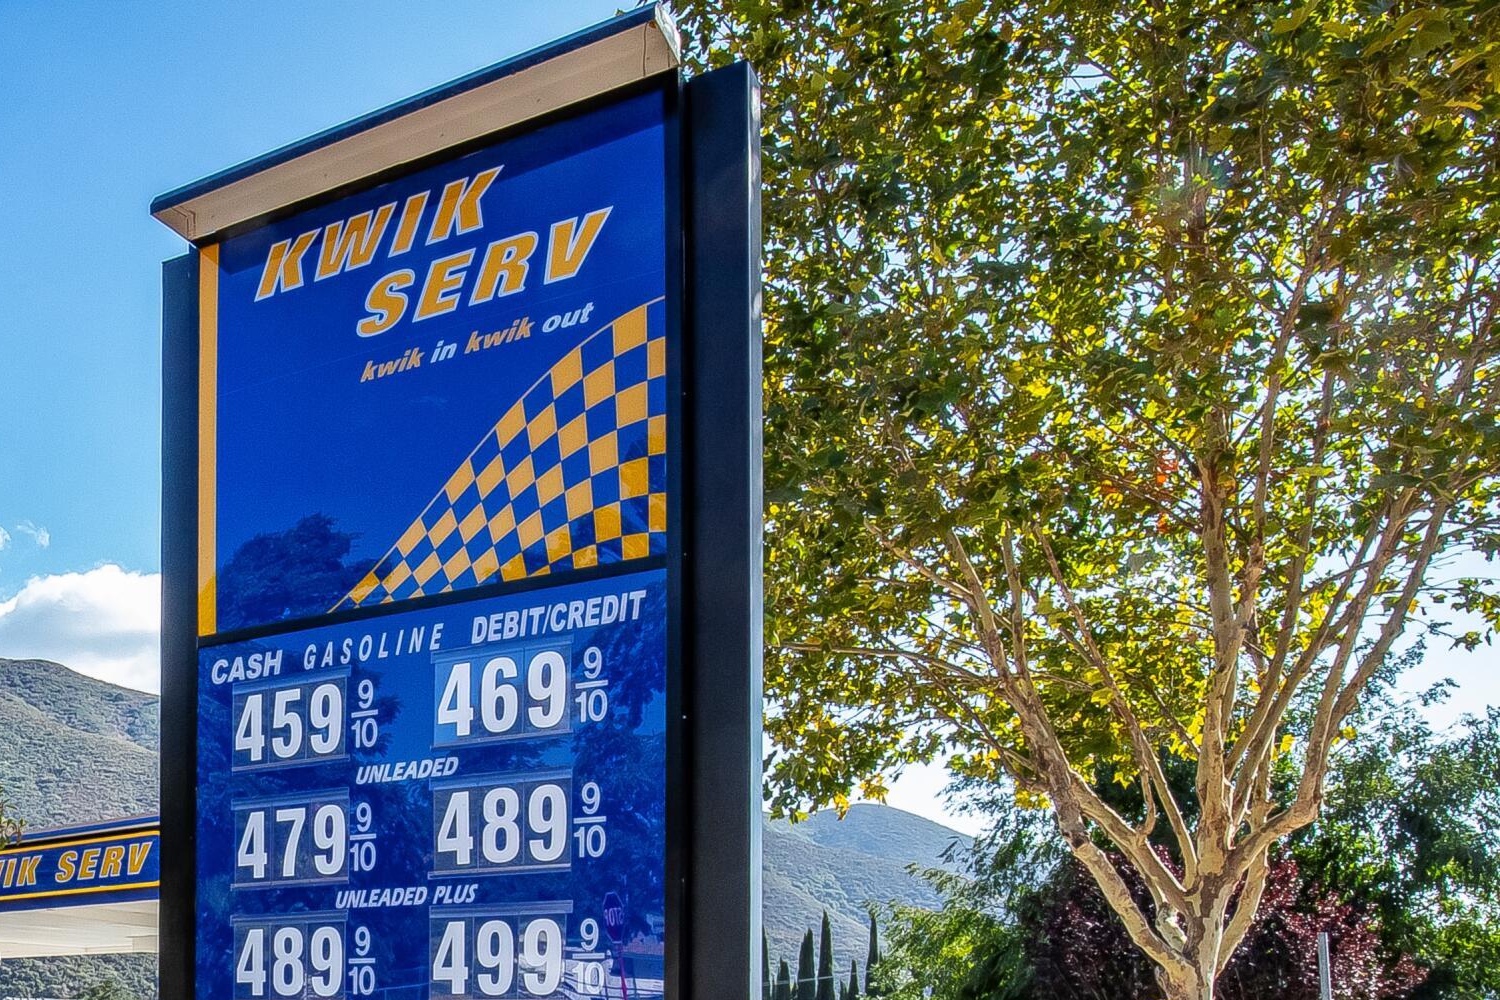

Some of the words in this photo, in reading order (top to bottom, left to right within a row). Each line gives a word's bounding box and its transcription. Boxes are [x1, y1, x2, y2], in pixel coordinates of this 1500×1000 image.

[255, 165, 504, 301] KWIK
[357, 206, 613, 337] SERV
[361, 346, 422, 382] kwik
[431, 341, 456, 363] in
[465, 317, 534, 354] kwik
[543, 303, 594, 333] out
[211, 650, 283, 685] CASH
[304, 622, 445, 670] GASOLINE
[471, 590, 647, 645] DEBIT/CREDIT
[583, 646, 603, 679] 9
[357, 679, 374, 710] 9
[438, 650, 567, 737] 469
[575, 688, 608, 723] 10
[235, 682, 343, 762] 459
[351, 717, 378, 749] 10
[355, 756, 459, 786] UNLEADED
[581, 781, 601, 815] 9
[356, 802, 373, 832] 9
[437, 783, 568, 866] 489
[237, 803, 346, 879] 479
[349, 841, 376, 873] 10
[574, 823, 607, 858] 10
[55, 841, 153, 884] SERV
[335, 886, 428, 910] UNLEADED
[433, 883, 478, 905] PLUS
[355, 926, 372, 956] 9
[580, 918, 600, 951] 9
[236, 926, 344, 996] 489
[432, 918, 565, 996] 499
[349, 965, 376, 996] 10
[572, 961, 605, 995] 10
